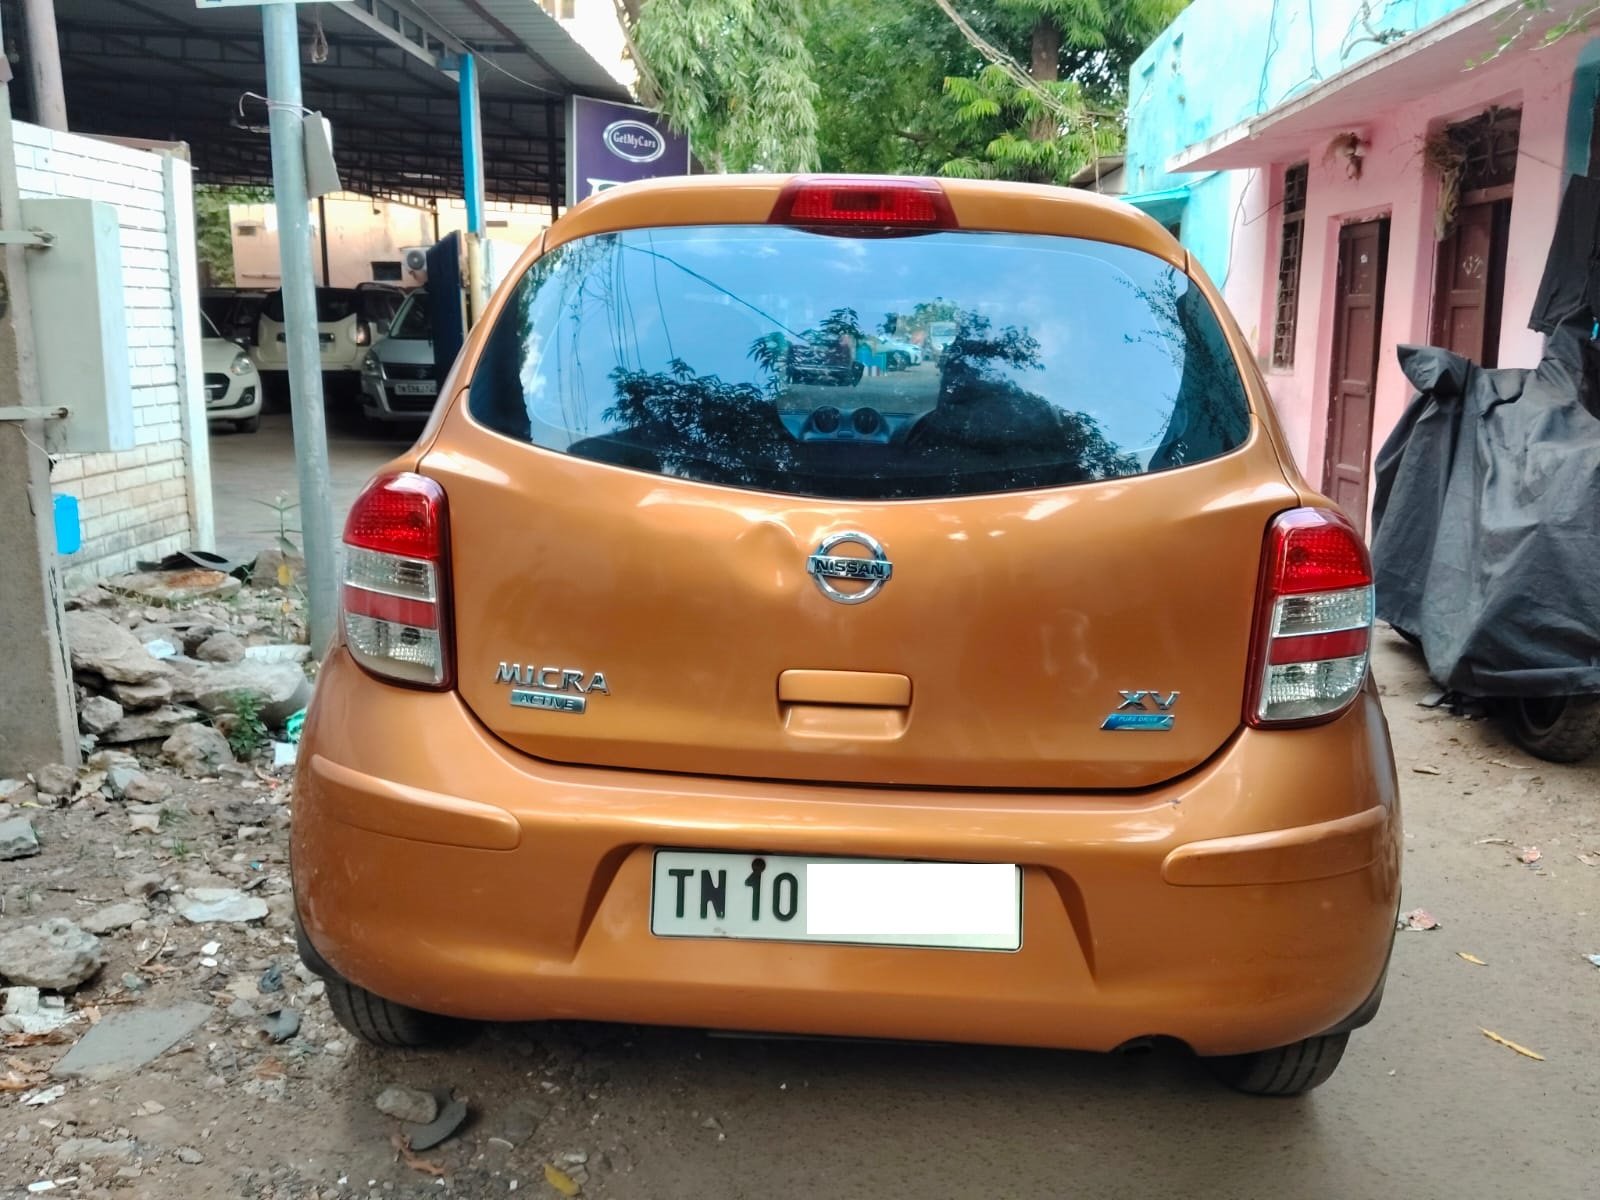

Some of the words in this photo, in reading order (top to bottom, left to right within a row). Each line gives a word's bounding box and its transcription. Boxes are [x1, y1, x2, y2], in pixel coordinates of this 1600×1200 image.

[612, 131, 657, 149] GetMyCars
[815, 559, 884, 578] NISSAN
[495, 661, 611, 696] MICRA
[519, 694, 575, 711] ACTIVE
[1116, 690, 1181, 710] XV
[668, 868, 727, 919] TN
[744, 868, 799, 922] 10
